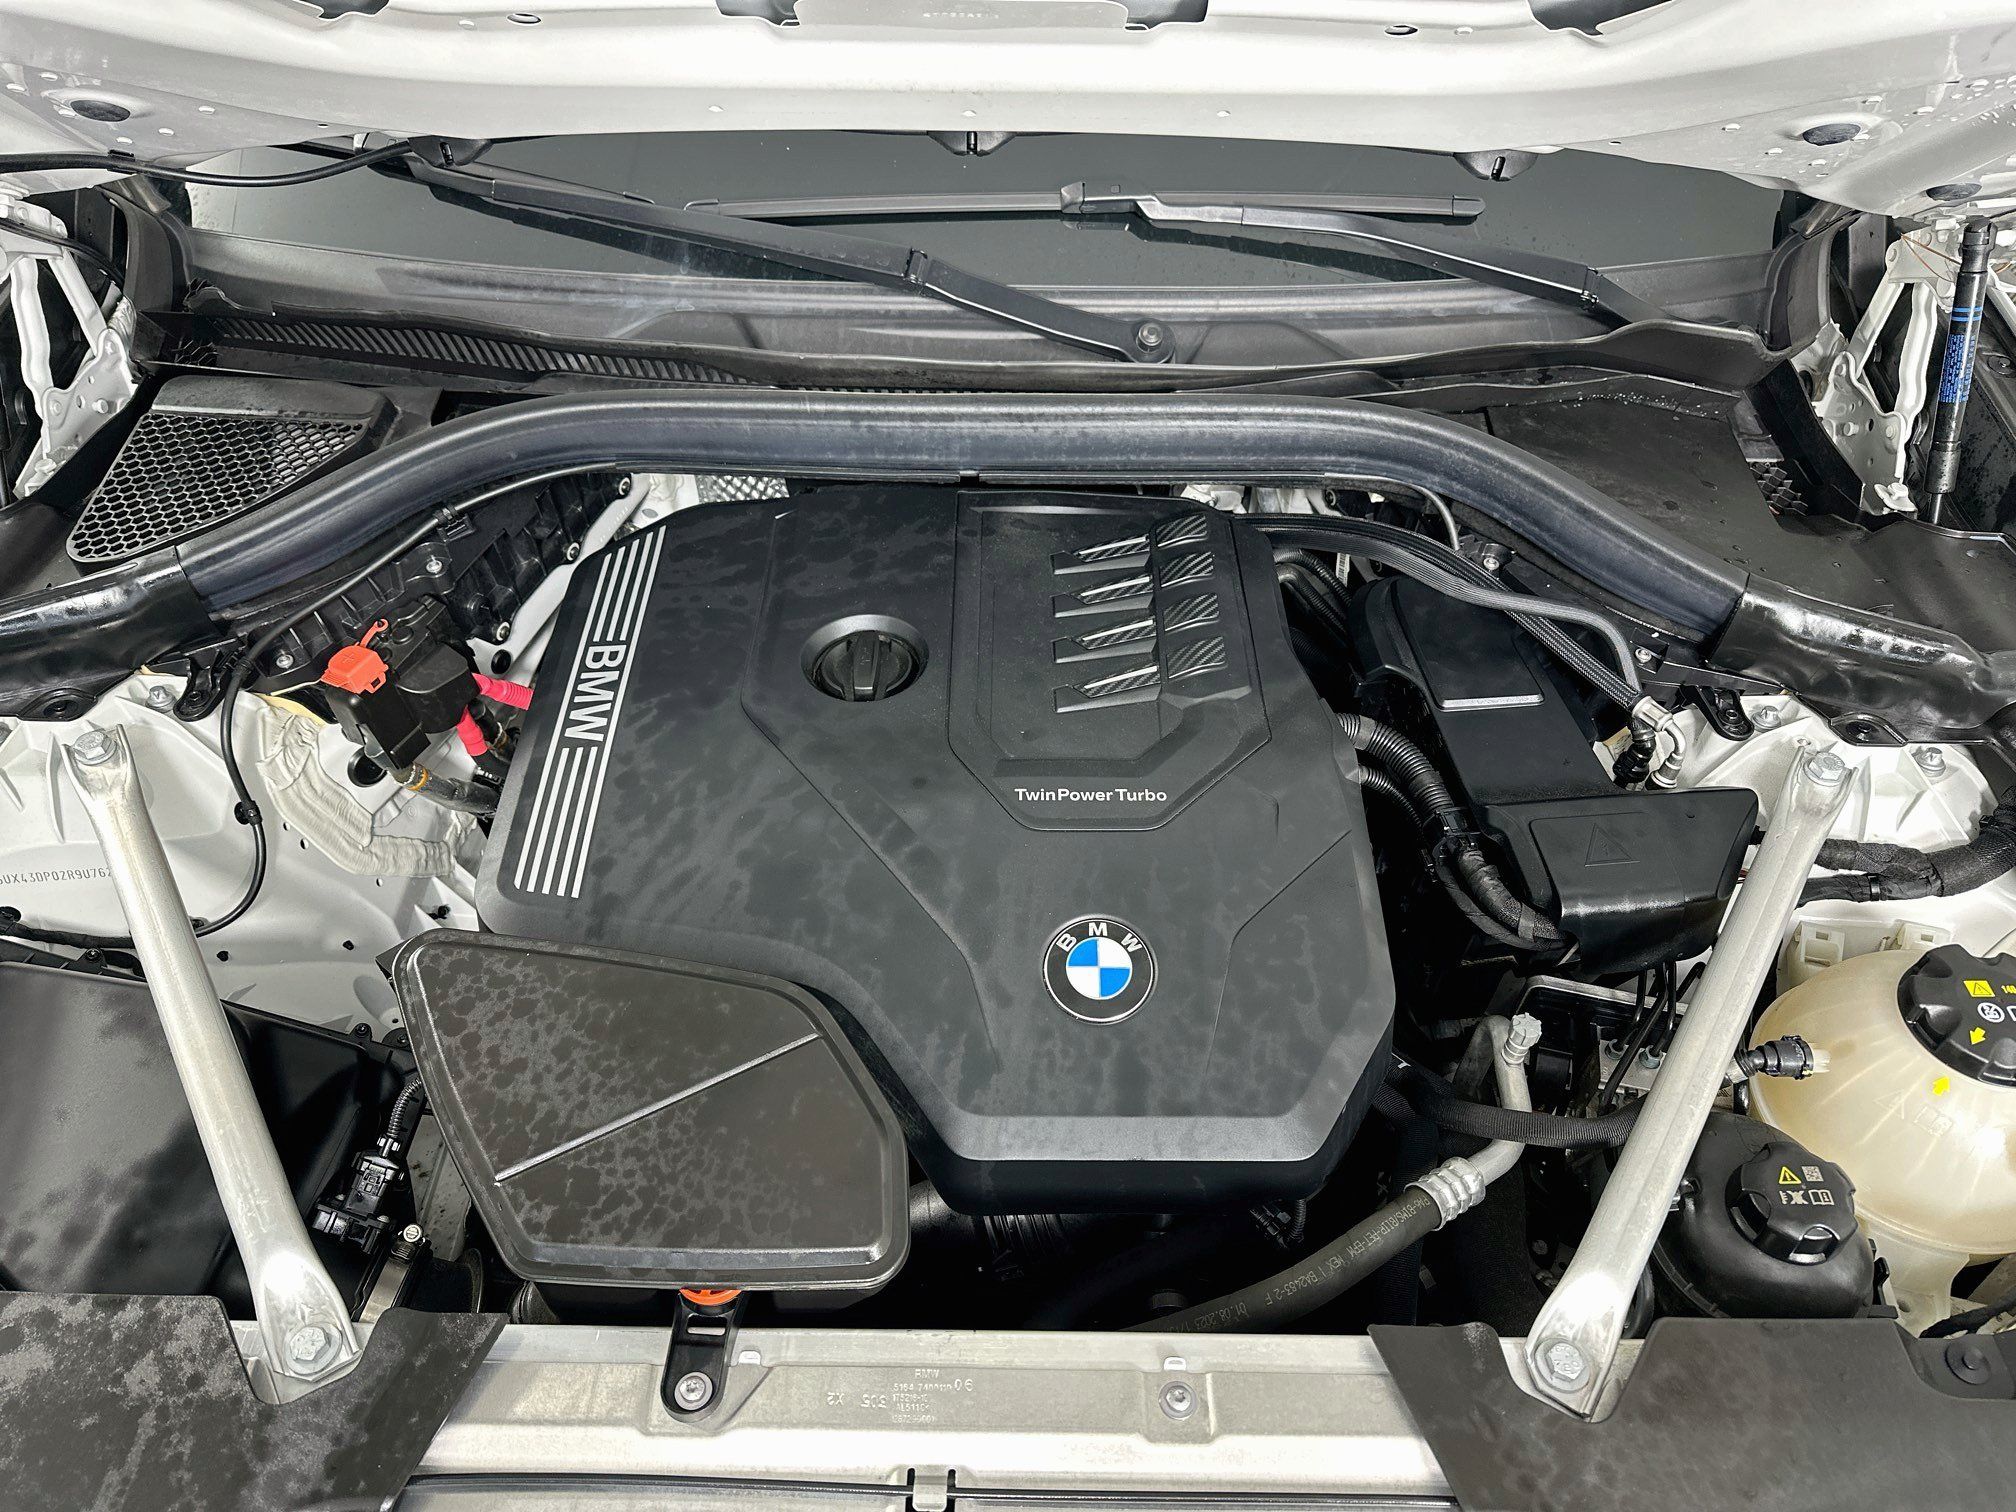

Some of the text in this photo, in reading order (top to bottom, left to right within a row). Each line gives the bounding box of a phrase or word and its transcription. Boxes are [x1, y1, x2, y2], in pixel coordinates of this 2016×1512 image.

[564, 644, 627, 742] BMW
[1014, 788, 1168, 801] TwinPower Turbo
[1056, 922, 1143, 953] BMW
